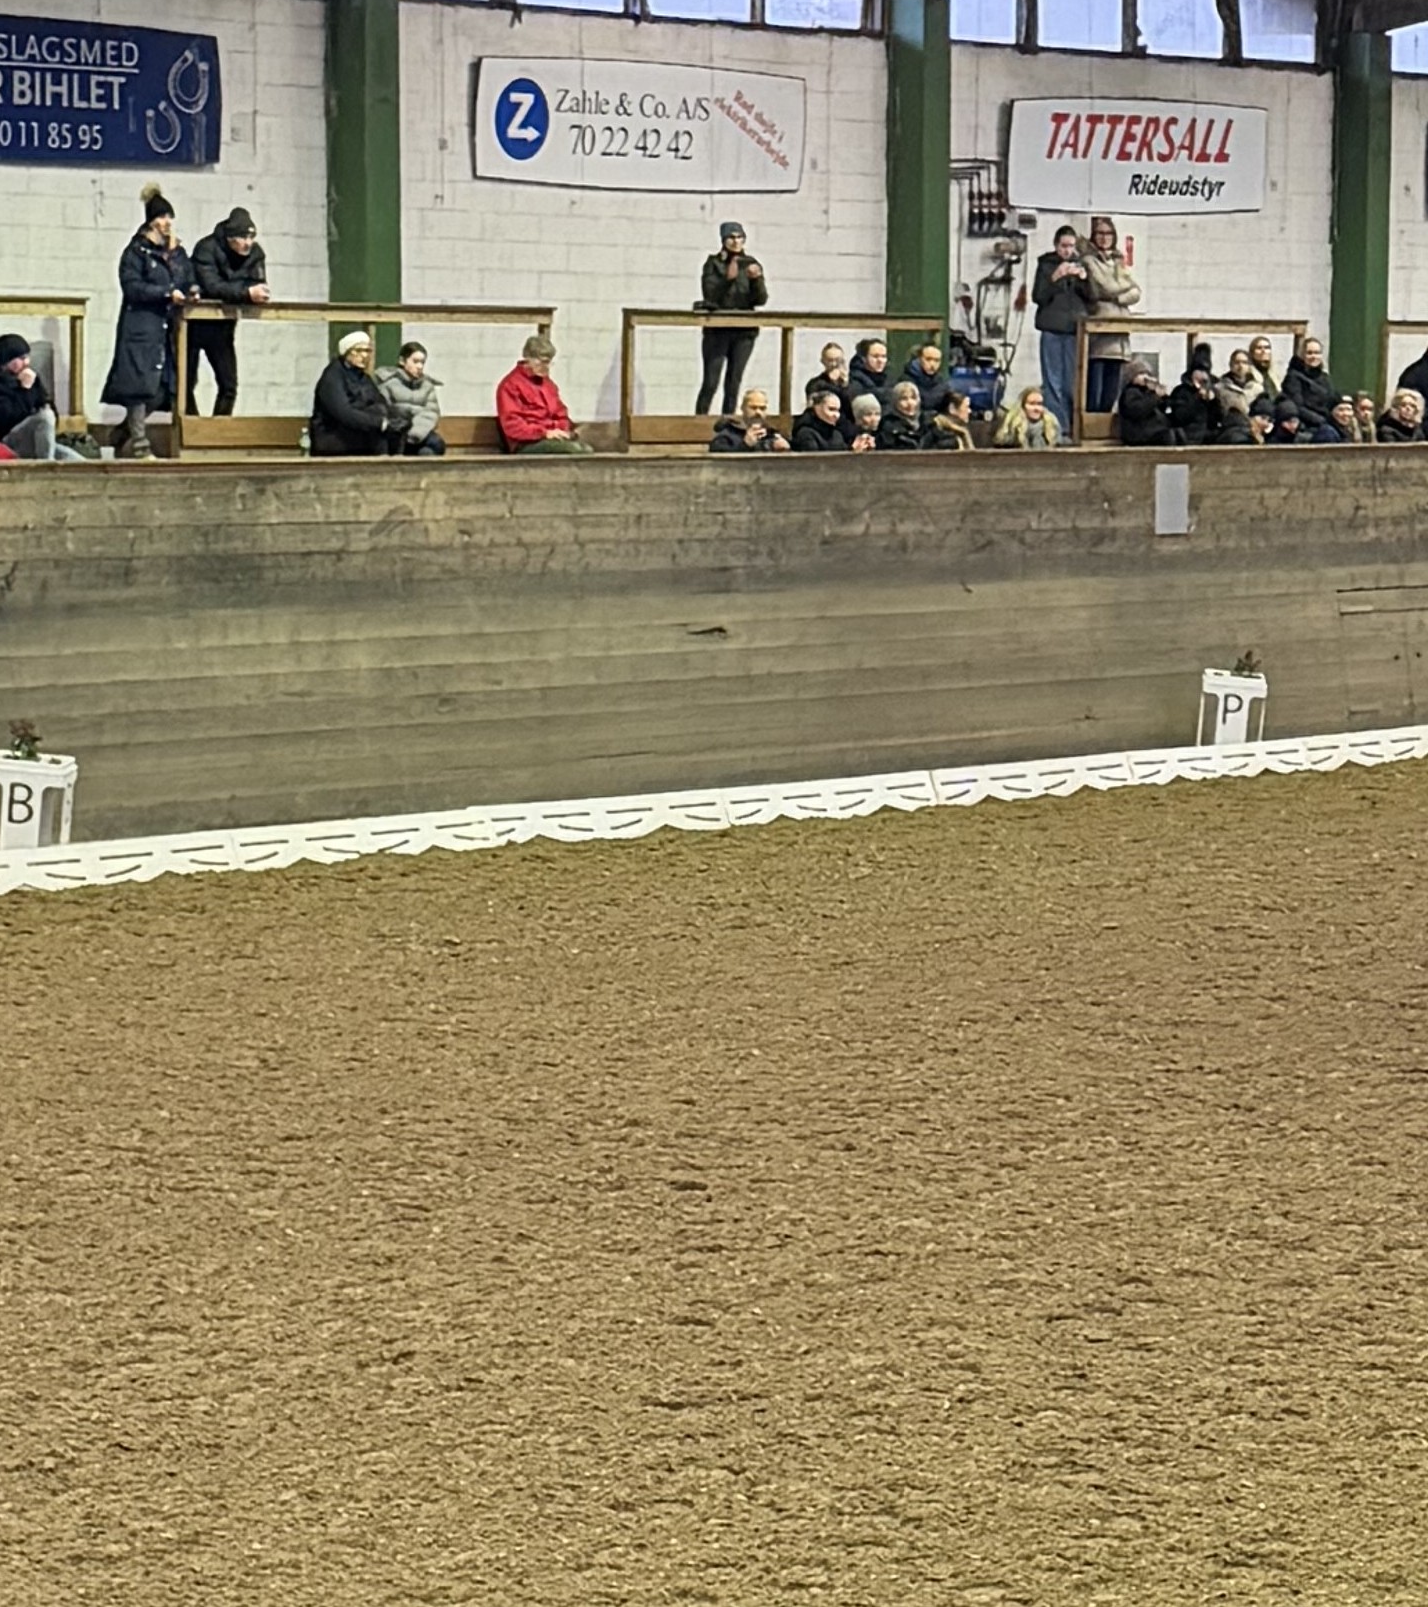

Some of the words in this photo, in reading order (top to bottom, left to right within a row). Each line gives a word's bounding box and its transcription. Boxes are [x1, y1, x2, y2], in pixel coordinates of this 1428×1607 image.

[12, 70, 126, 110] BIHLET
[614, 92, 633, 117] &
[639, 93, 671, 119] Co.
[676, 96, 711, 122] A/S
[18, 122, 40, 148] 11
[47, 123, 74, 150] 85
[78, 124, 104, 151] 95
[569, 124, 596, 156] 70
[600, 126, 629, 157] 22
[634, 128, 662, 159] 42
[667, 129, 694, 161] 42
[1045, 112, 1234, 163] TATTERSALL
[1128, 173, 1226, 201] Rideudstyr
[1222, 694, 1243, 725] P
[8, 782, 33, 824] B
